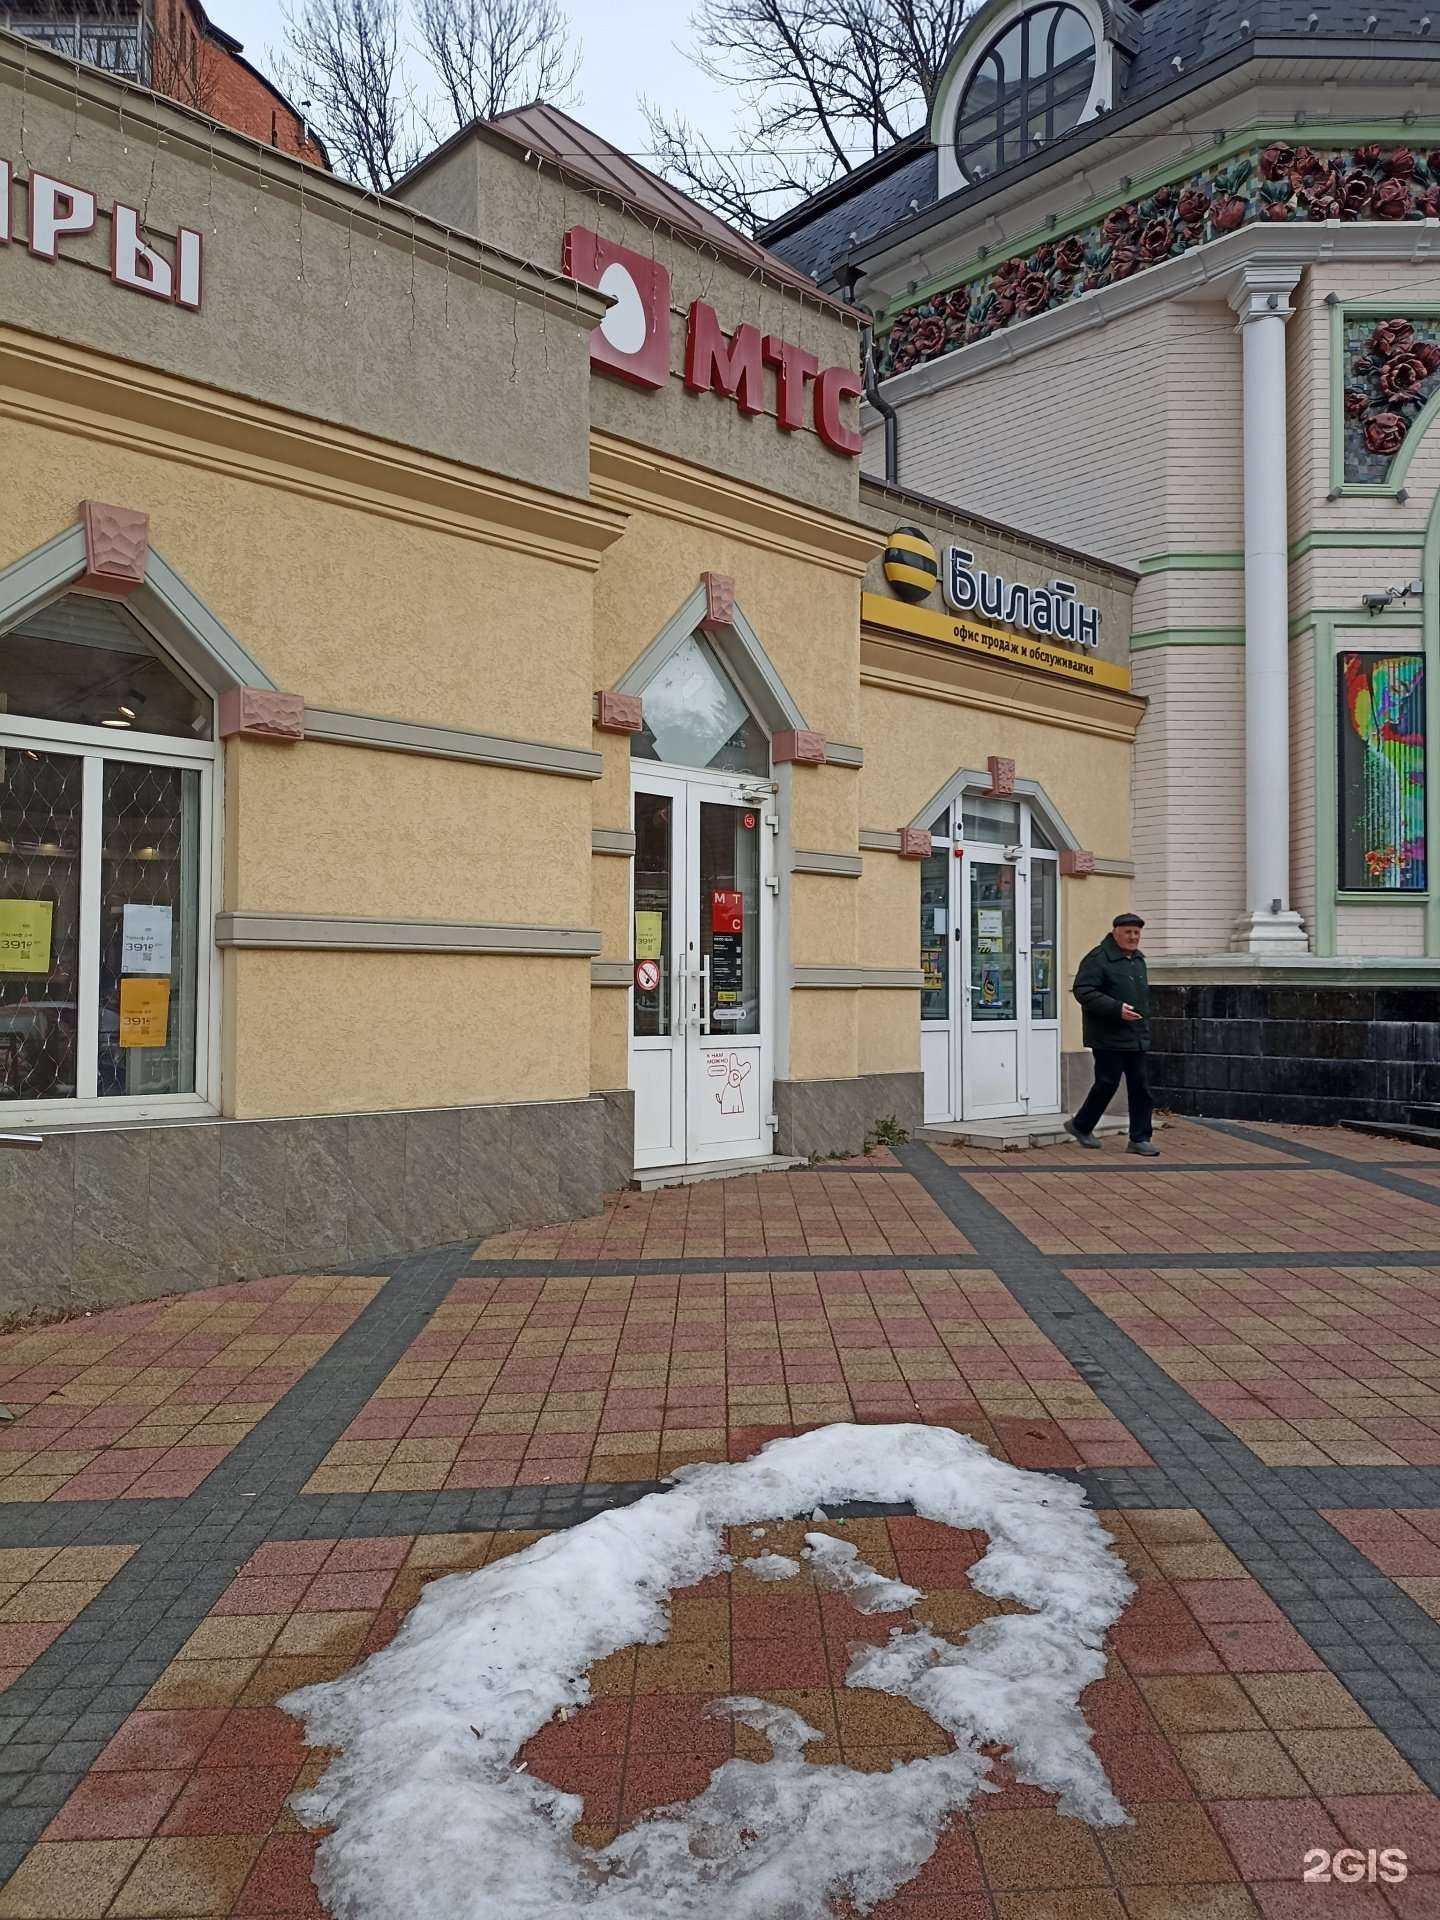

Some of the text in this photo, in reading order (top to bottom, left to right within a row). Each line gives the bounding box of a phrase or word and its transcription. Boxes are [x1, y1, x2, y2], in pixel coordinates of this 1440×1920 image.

[684, 300, 864, 457] МТС
[953, 625, 1094, 676] офис продаж и обслуживания
[714, 893, 741, 904] М Т
[732, 918, 741, 930] С
